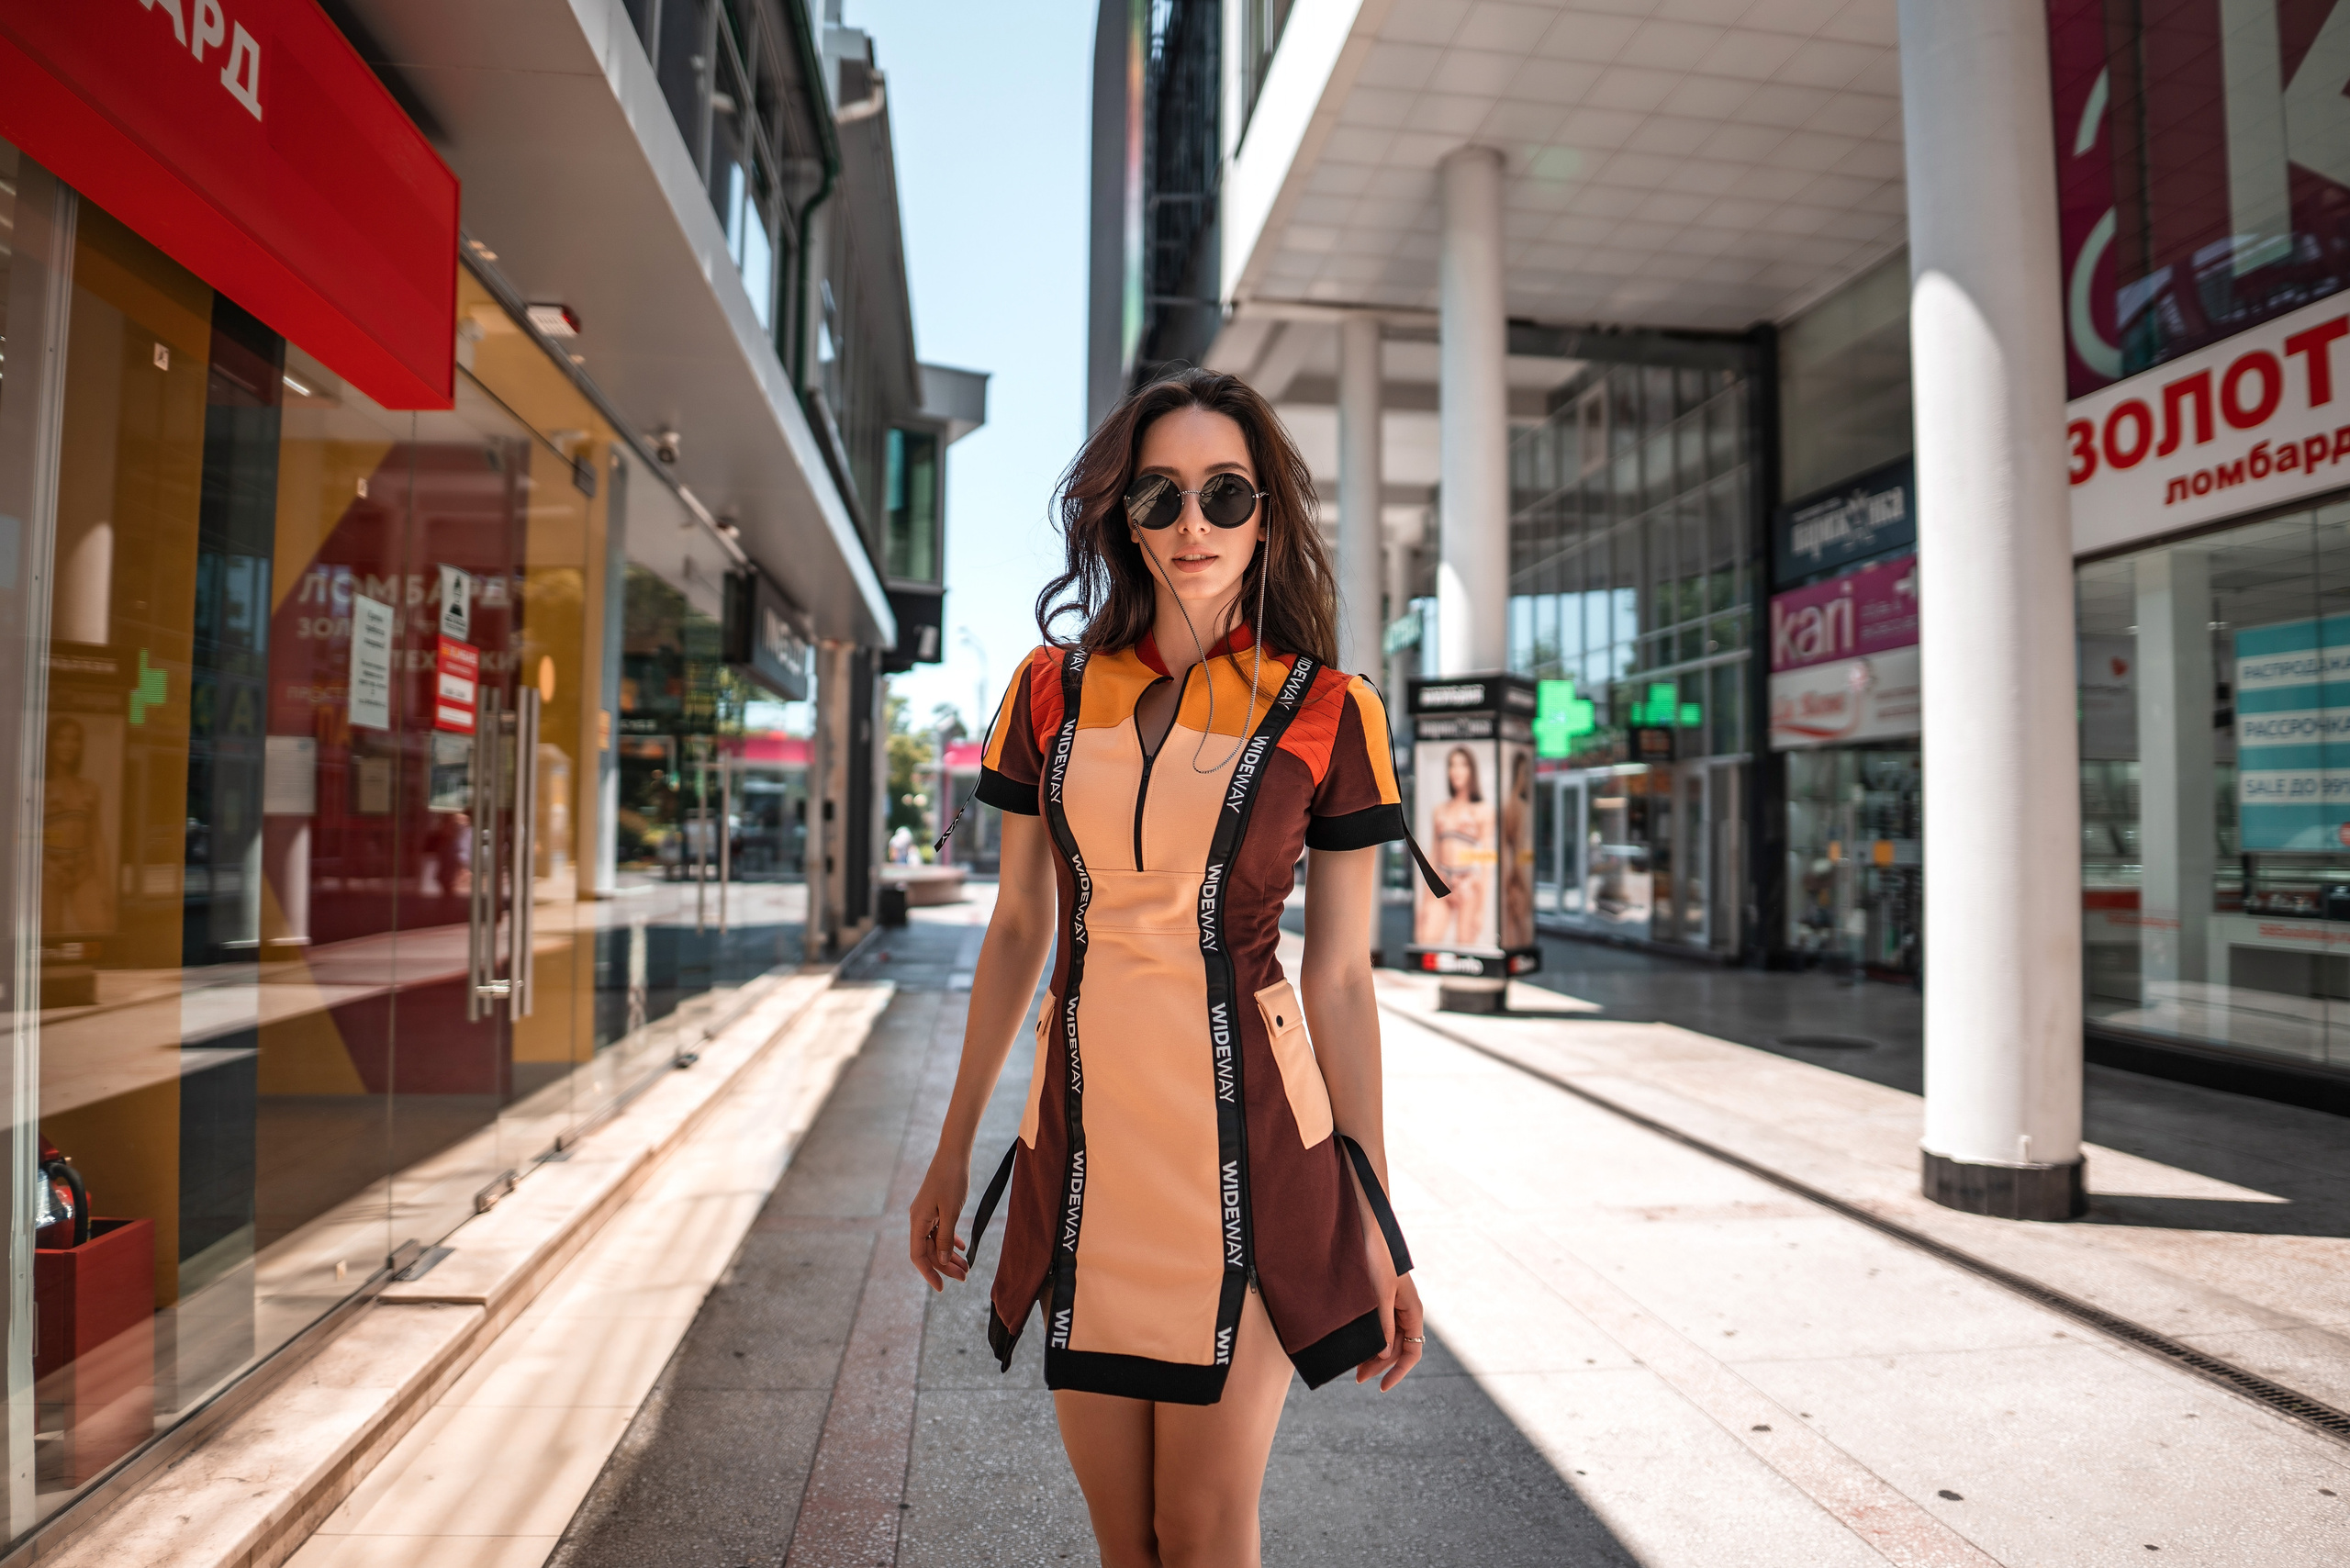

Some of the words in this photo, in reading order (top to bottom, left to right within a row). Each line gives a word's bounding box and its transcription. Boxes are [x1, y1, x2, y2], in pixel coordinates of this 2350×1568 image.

[1770, 579, 1854, 667] kari
[1050, 718, 1077, 804] WIDEWAY
[1226, 735, 1270, 813] WIDEWAY
[2246, 778, 2286, 795] SALE
[1071, 853, 1091, 945] WIDEWAY
[1200, 863, 1224, 952] WIDEWAY
[1066, 995, 1081, 1094] WIDEWAY
[1211, 1002, 1235, 1103] WIDEWAY
[1062, 1149, 1085, 1252] WIDEWAY
[1222, 1159, 1244, 1268] WIDEWAY
